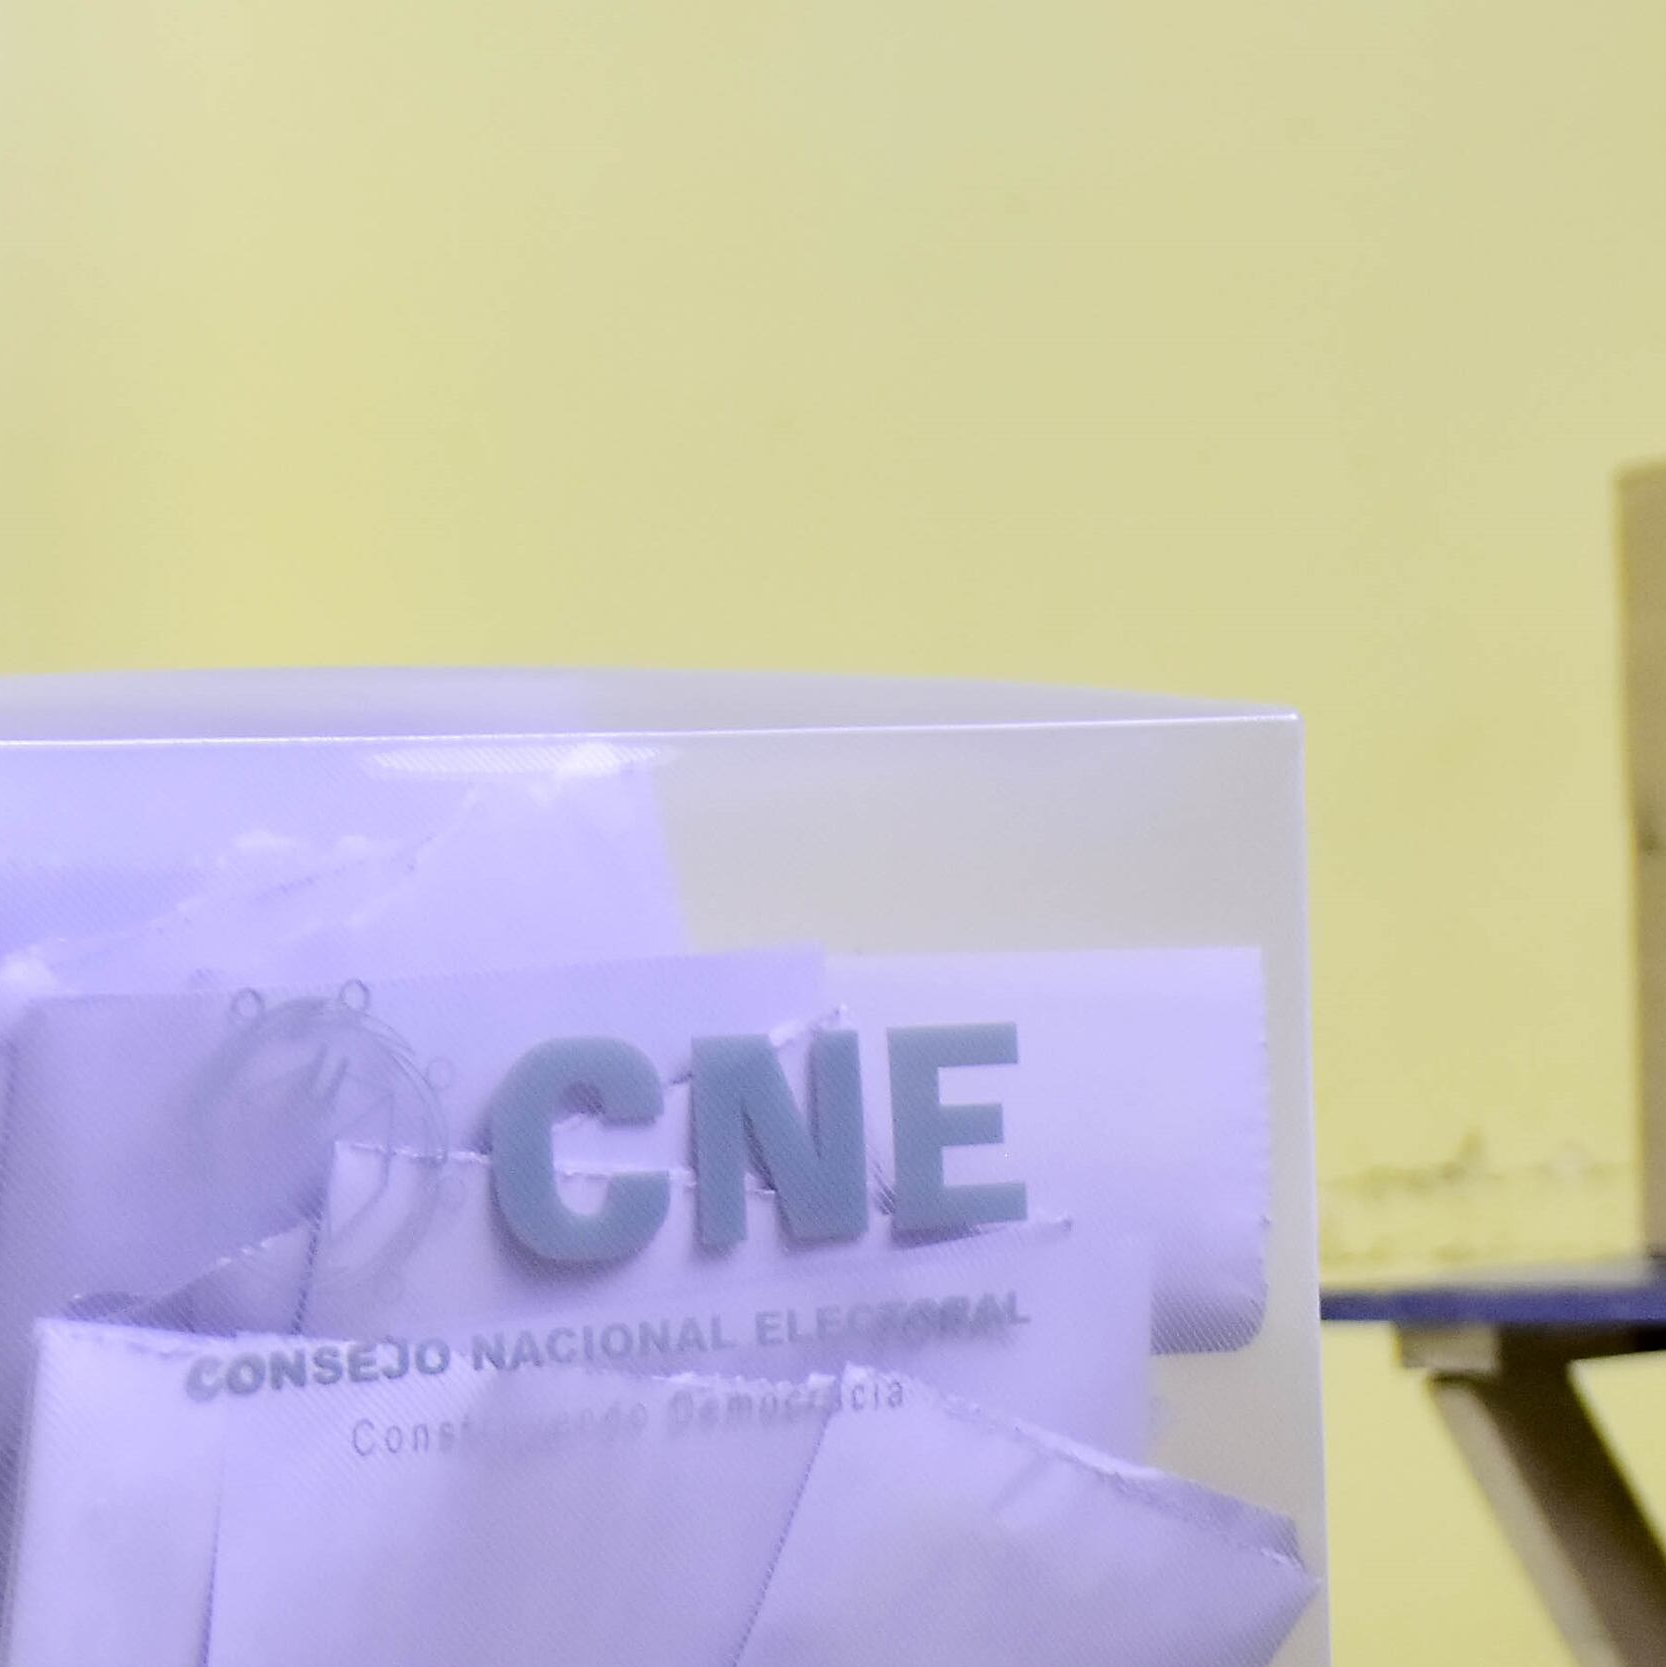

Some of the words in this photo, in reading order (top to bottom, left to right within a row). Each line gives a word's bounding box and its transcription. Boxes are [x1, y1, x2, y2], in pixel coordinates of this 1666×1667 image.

[490, 1021, 1029, 1264] CNE
[184, 1335, 452, 1402] CONSEJO
[470, 1315, 735, 1374] NACIONAL
[754, 1290, 1032, 1347] ELECTORAL
